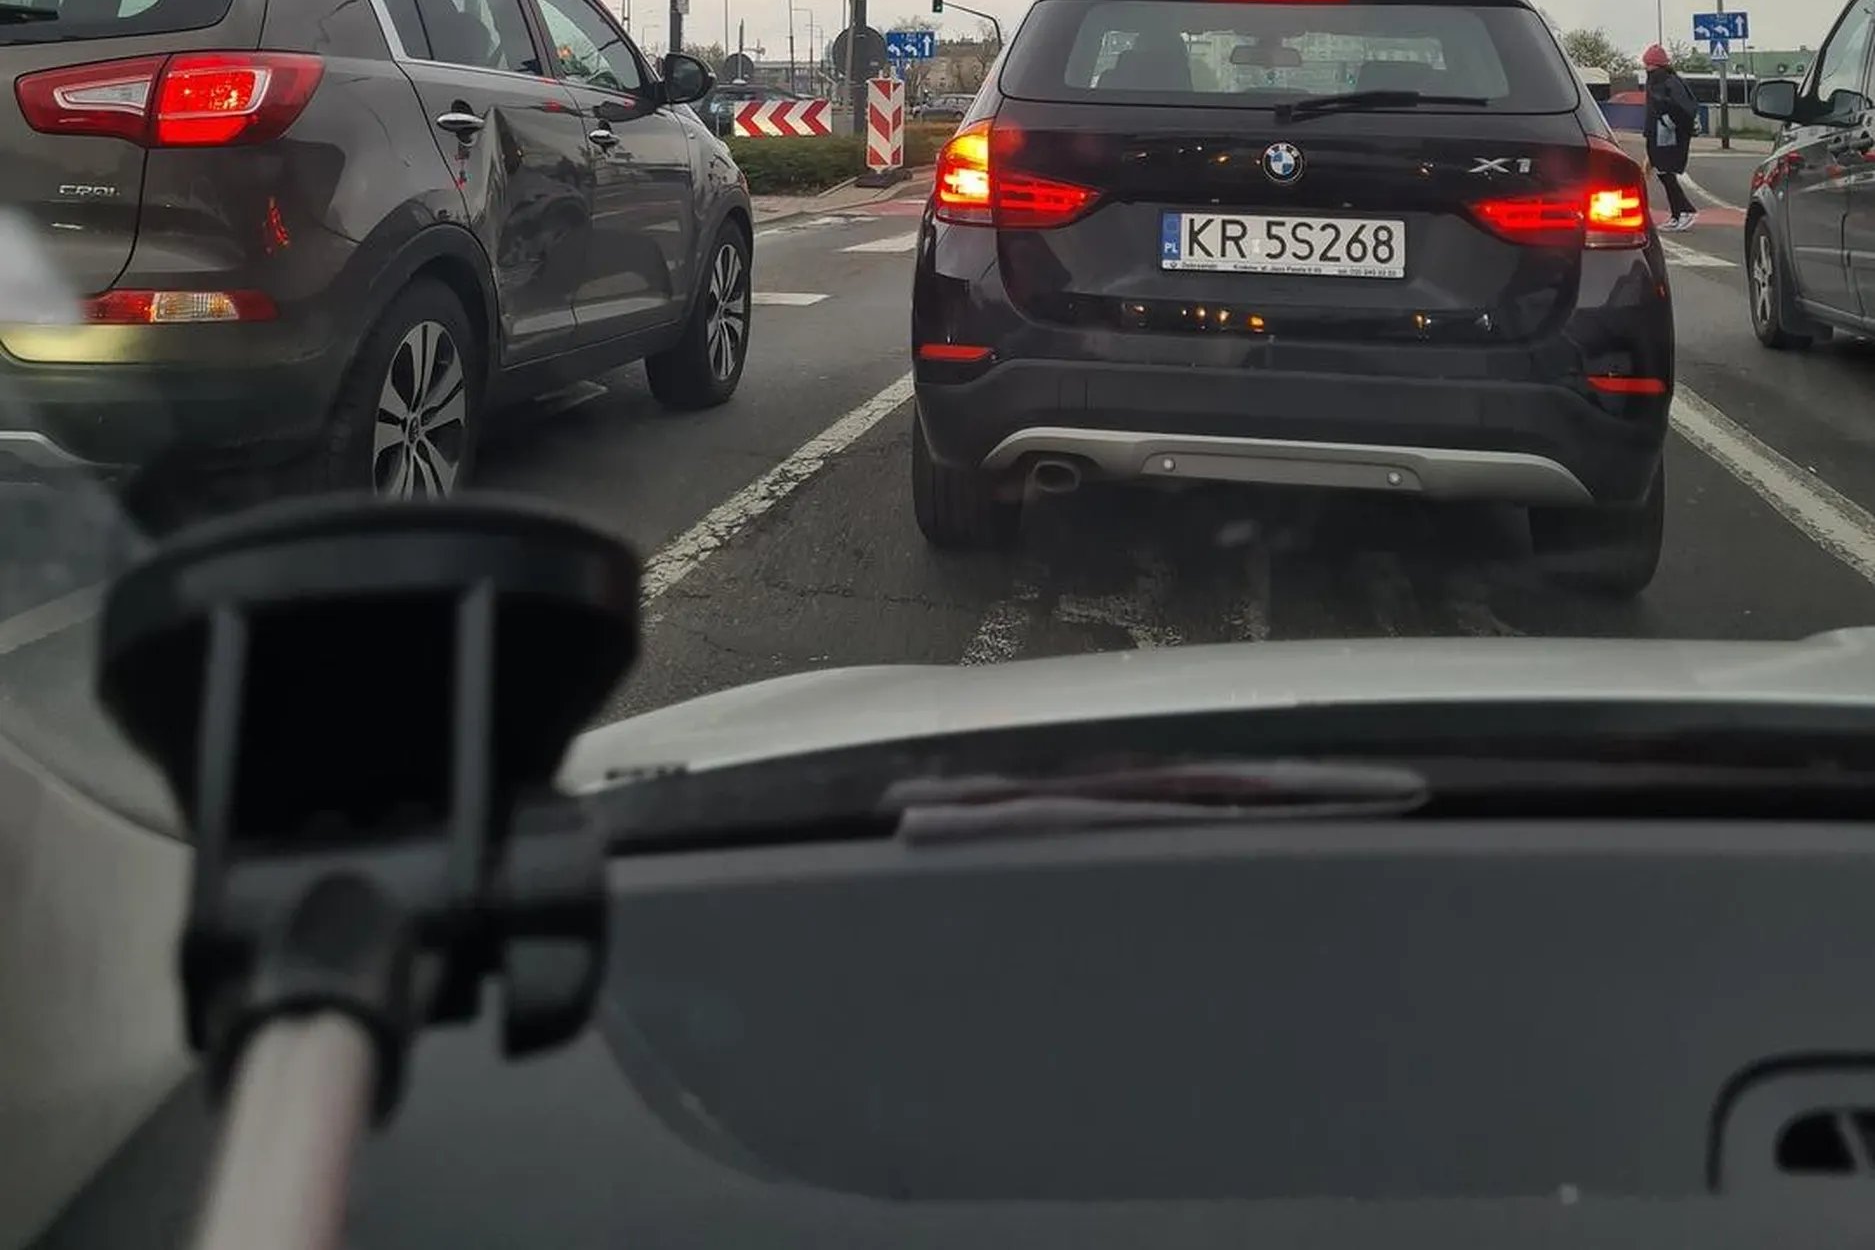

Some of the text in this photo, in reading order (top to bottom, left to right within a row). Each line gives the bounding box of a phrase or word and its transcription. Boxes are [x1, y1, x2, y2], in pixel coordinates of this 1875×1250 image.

[1468, 158, 1531, 173] X1
[1164, 242, 1179, 253] PL
[1188, 218, 1395, 264] KR 5S268
